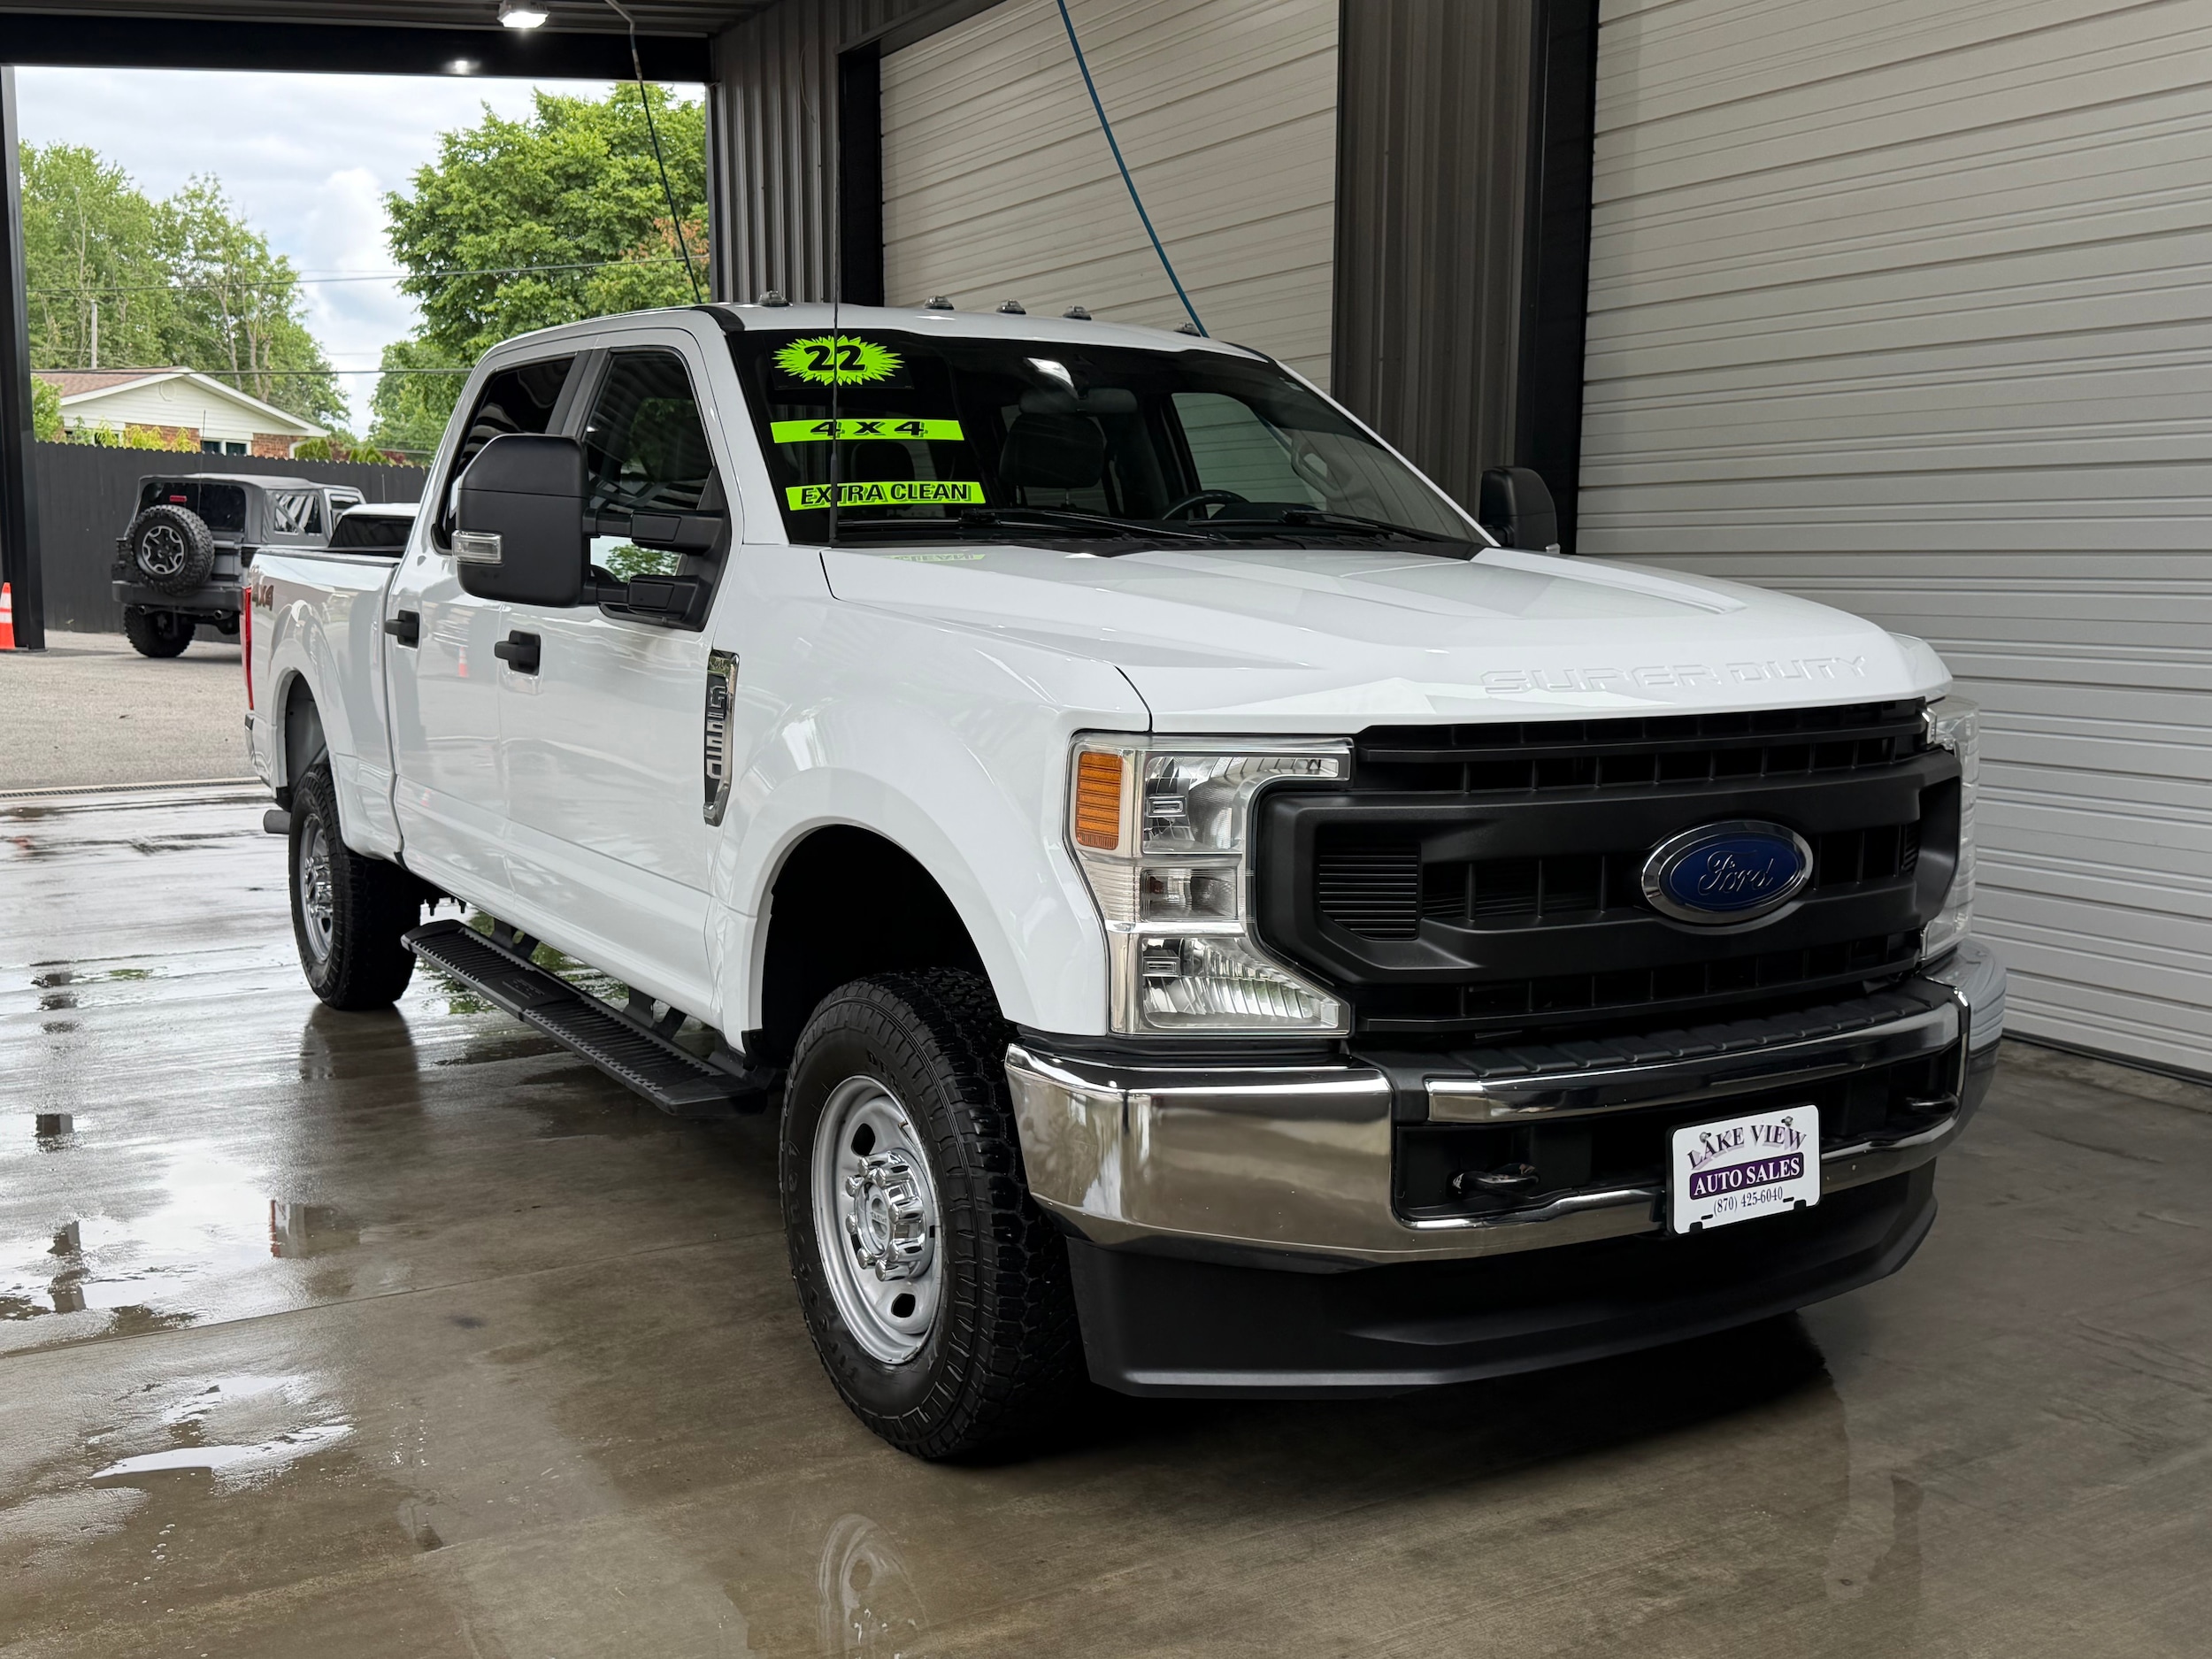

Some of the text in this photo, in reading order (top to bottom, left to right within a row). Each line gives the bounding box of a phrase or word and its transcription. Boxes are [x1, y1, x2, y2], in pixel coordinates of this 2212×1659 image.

[803, 345, 867, 372] 22
[891, 483, 972, 501] CLEAN
[1479, 656, 1865, 695] SUPER DUTY
[1697, 850, 1775, 896] Ford
[1687, 1125, 1807, 1171] LAKE VIEW
[1694, 1156, 1801, 1196] AUTO SALES
[1713, 1186, 1784, 1217] (870) 425-6040
